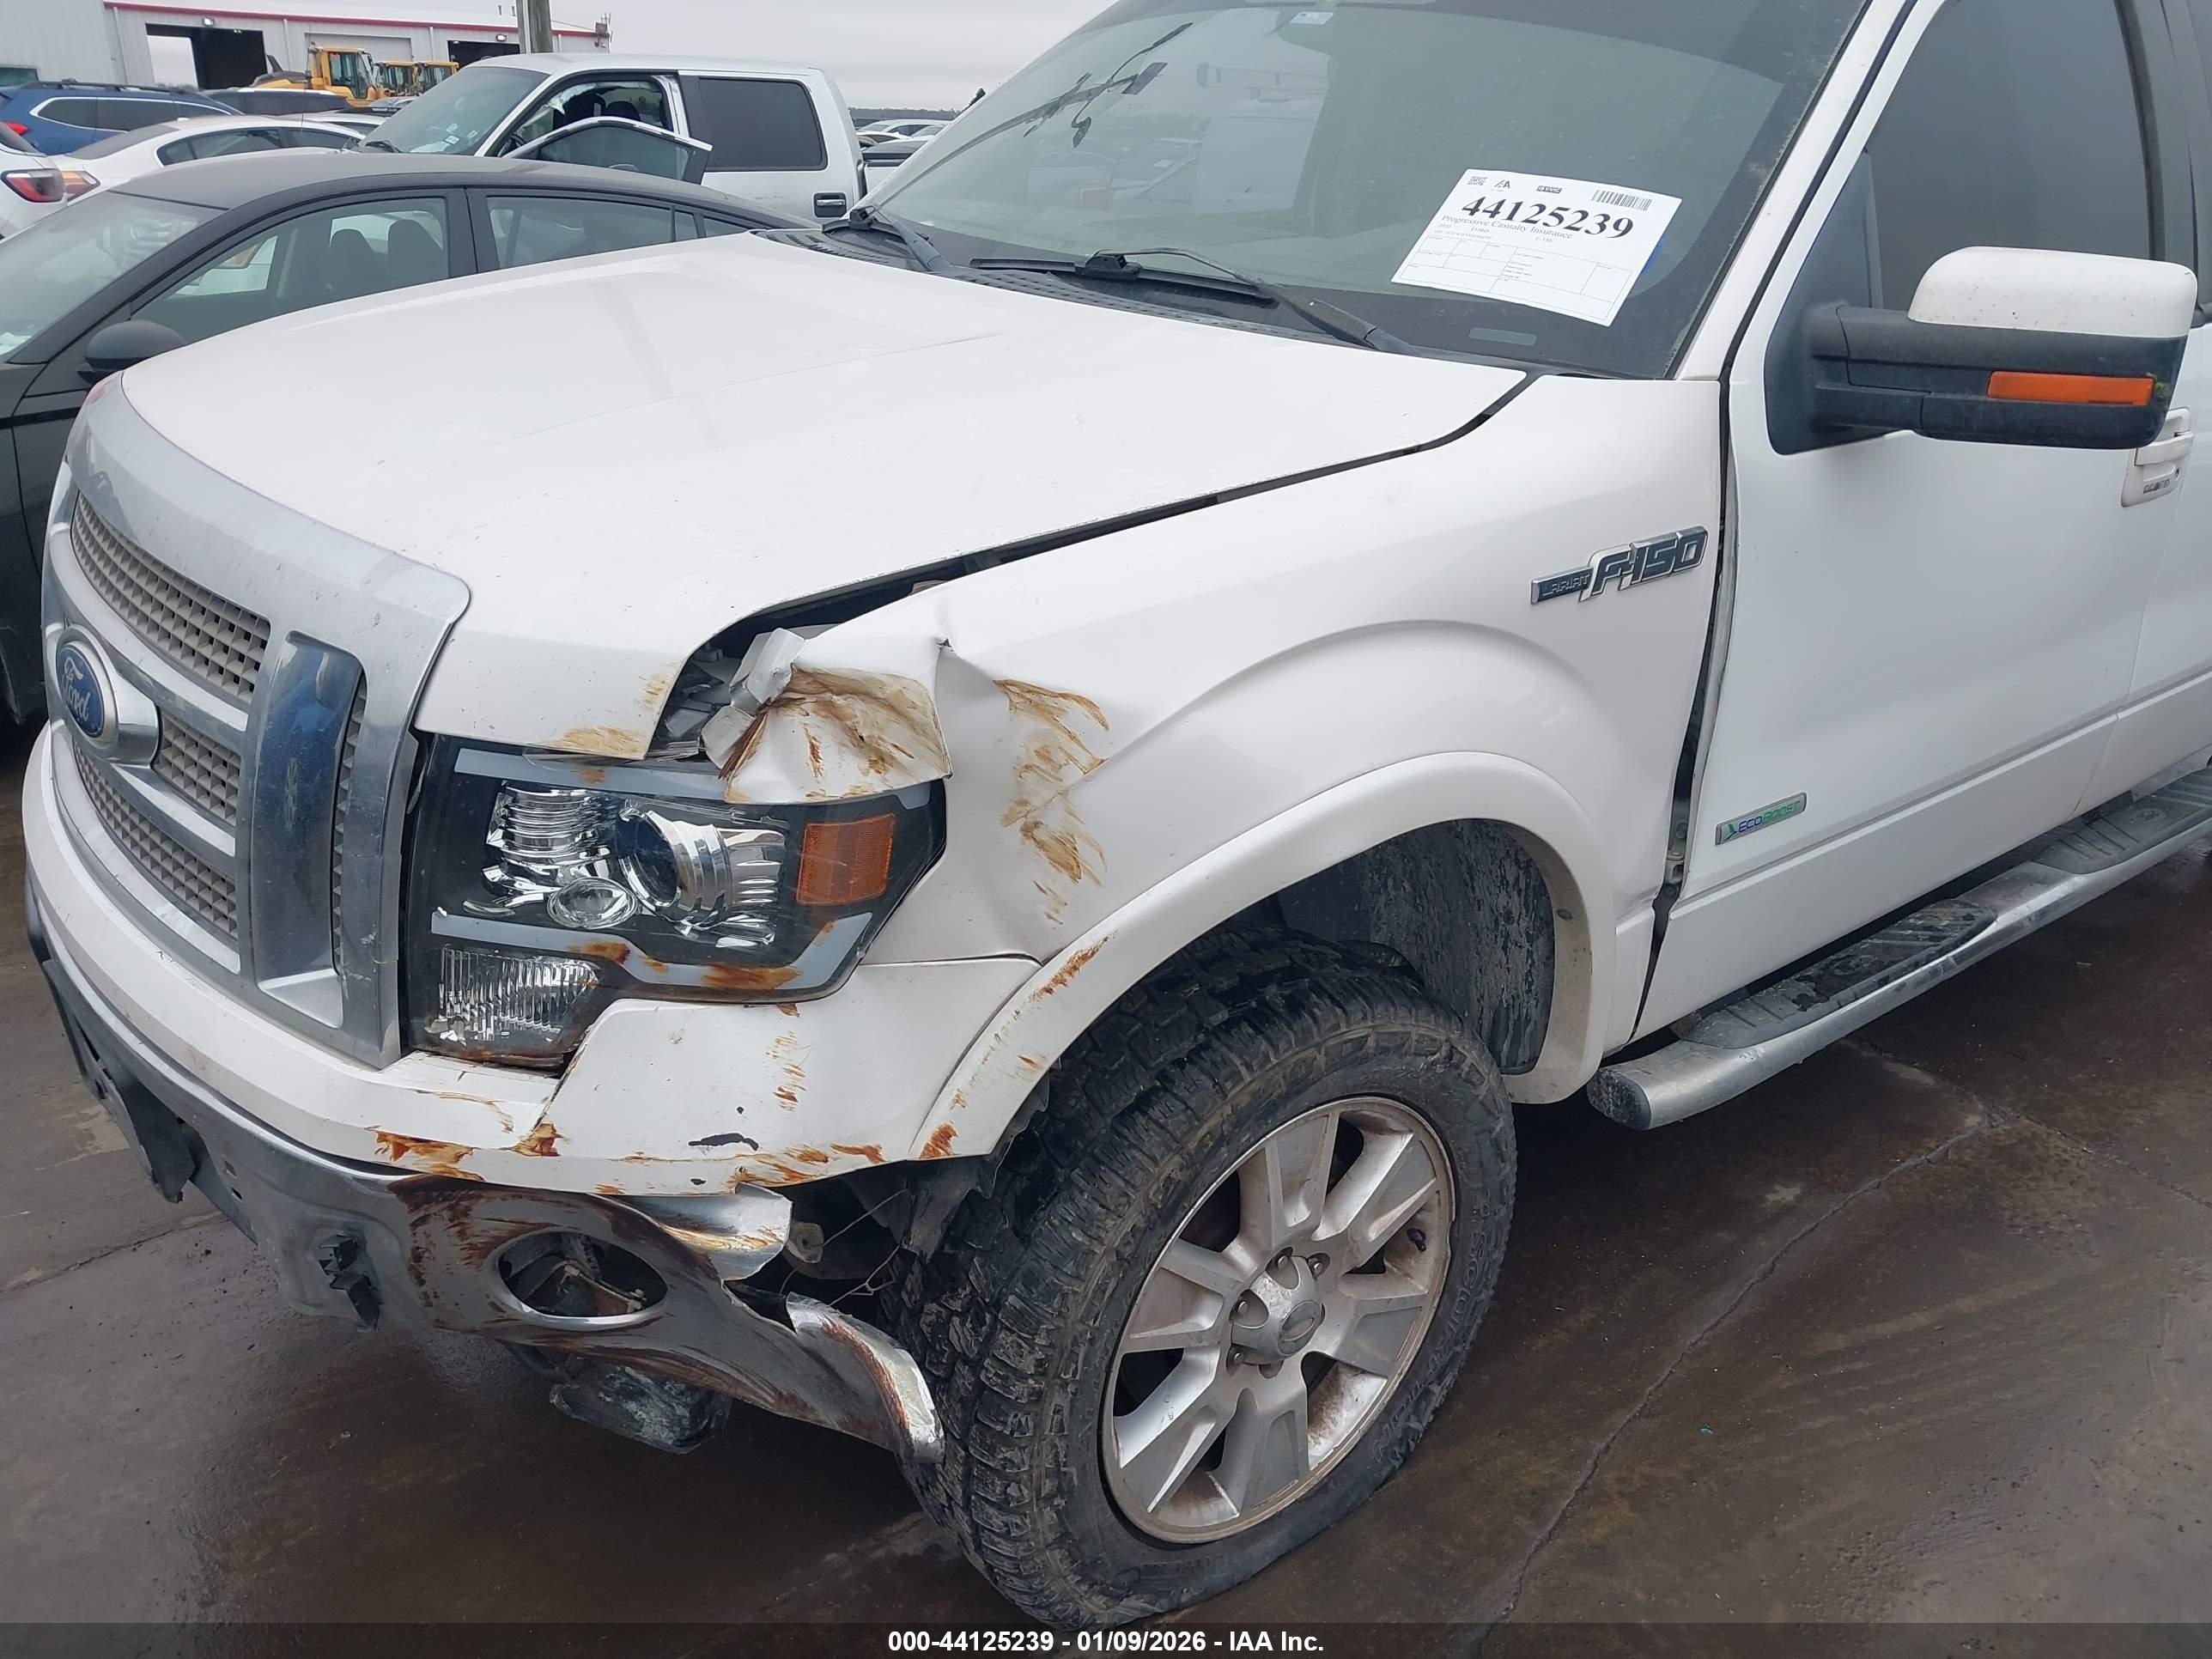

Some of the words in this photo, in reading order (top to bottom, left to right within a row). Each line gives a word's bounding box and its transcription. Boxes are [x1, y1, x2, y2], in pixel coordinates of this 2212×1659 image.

[1442, 215, 1490, 226] Progressive
[1491, 220, 1528, 232] Casualty
[1530, 226, 1572, 239] Insurance
[1462, 197, 1633, 238] 44125239
[1579, 526, 1709, 603] F-150
[63, 656, 91, 722] Ford
